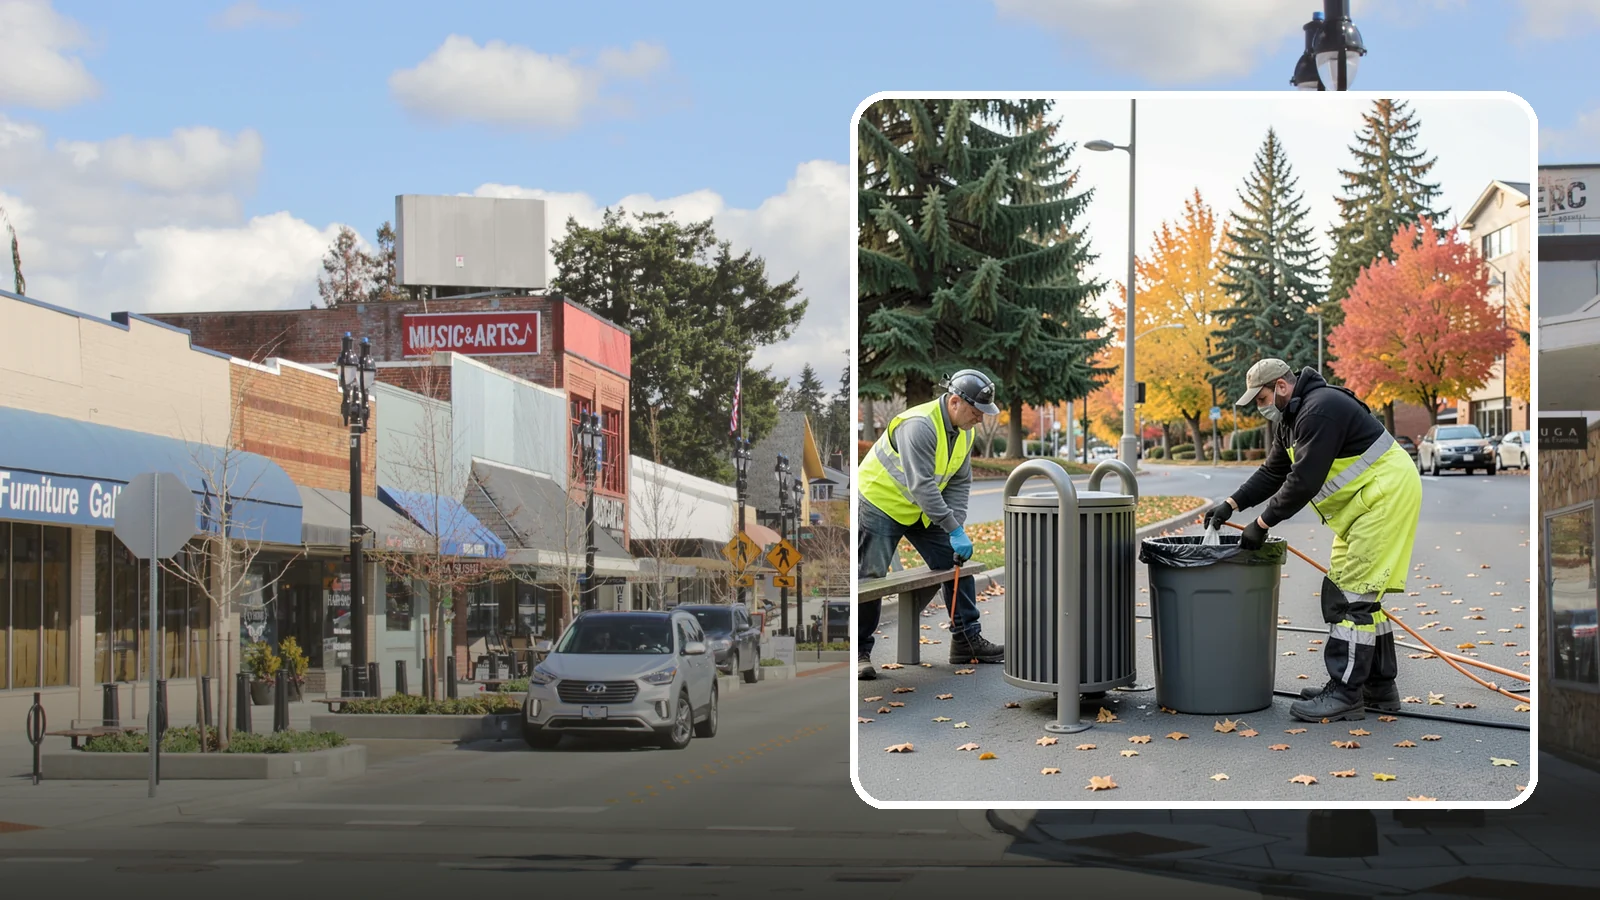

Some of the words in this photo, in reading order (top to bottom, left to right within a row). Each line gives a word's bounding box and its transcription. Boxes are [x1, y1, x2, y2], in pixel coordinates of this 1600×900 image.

[408, 322, 520, 349] MUSIC&ARTS
[1540, 428, 1577, 436] UGA
[0, 471, 79, 515] Furniture
[453, 563, 479, 574] SUSHI
